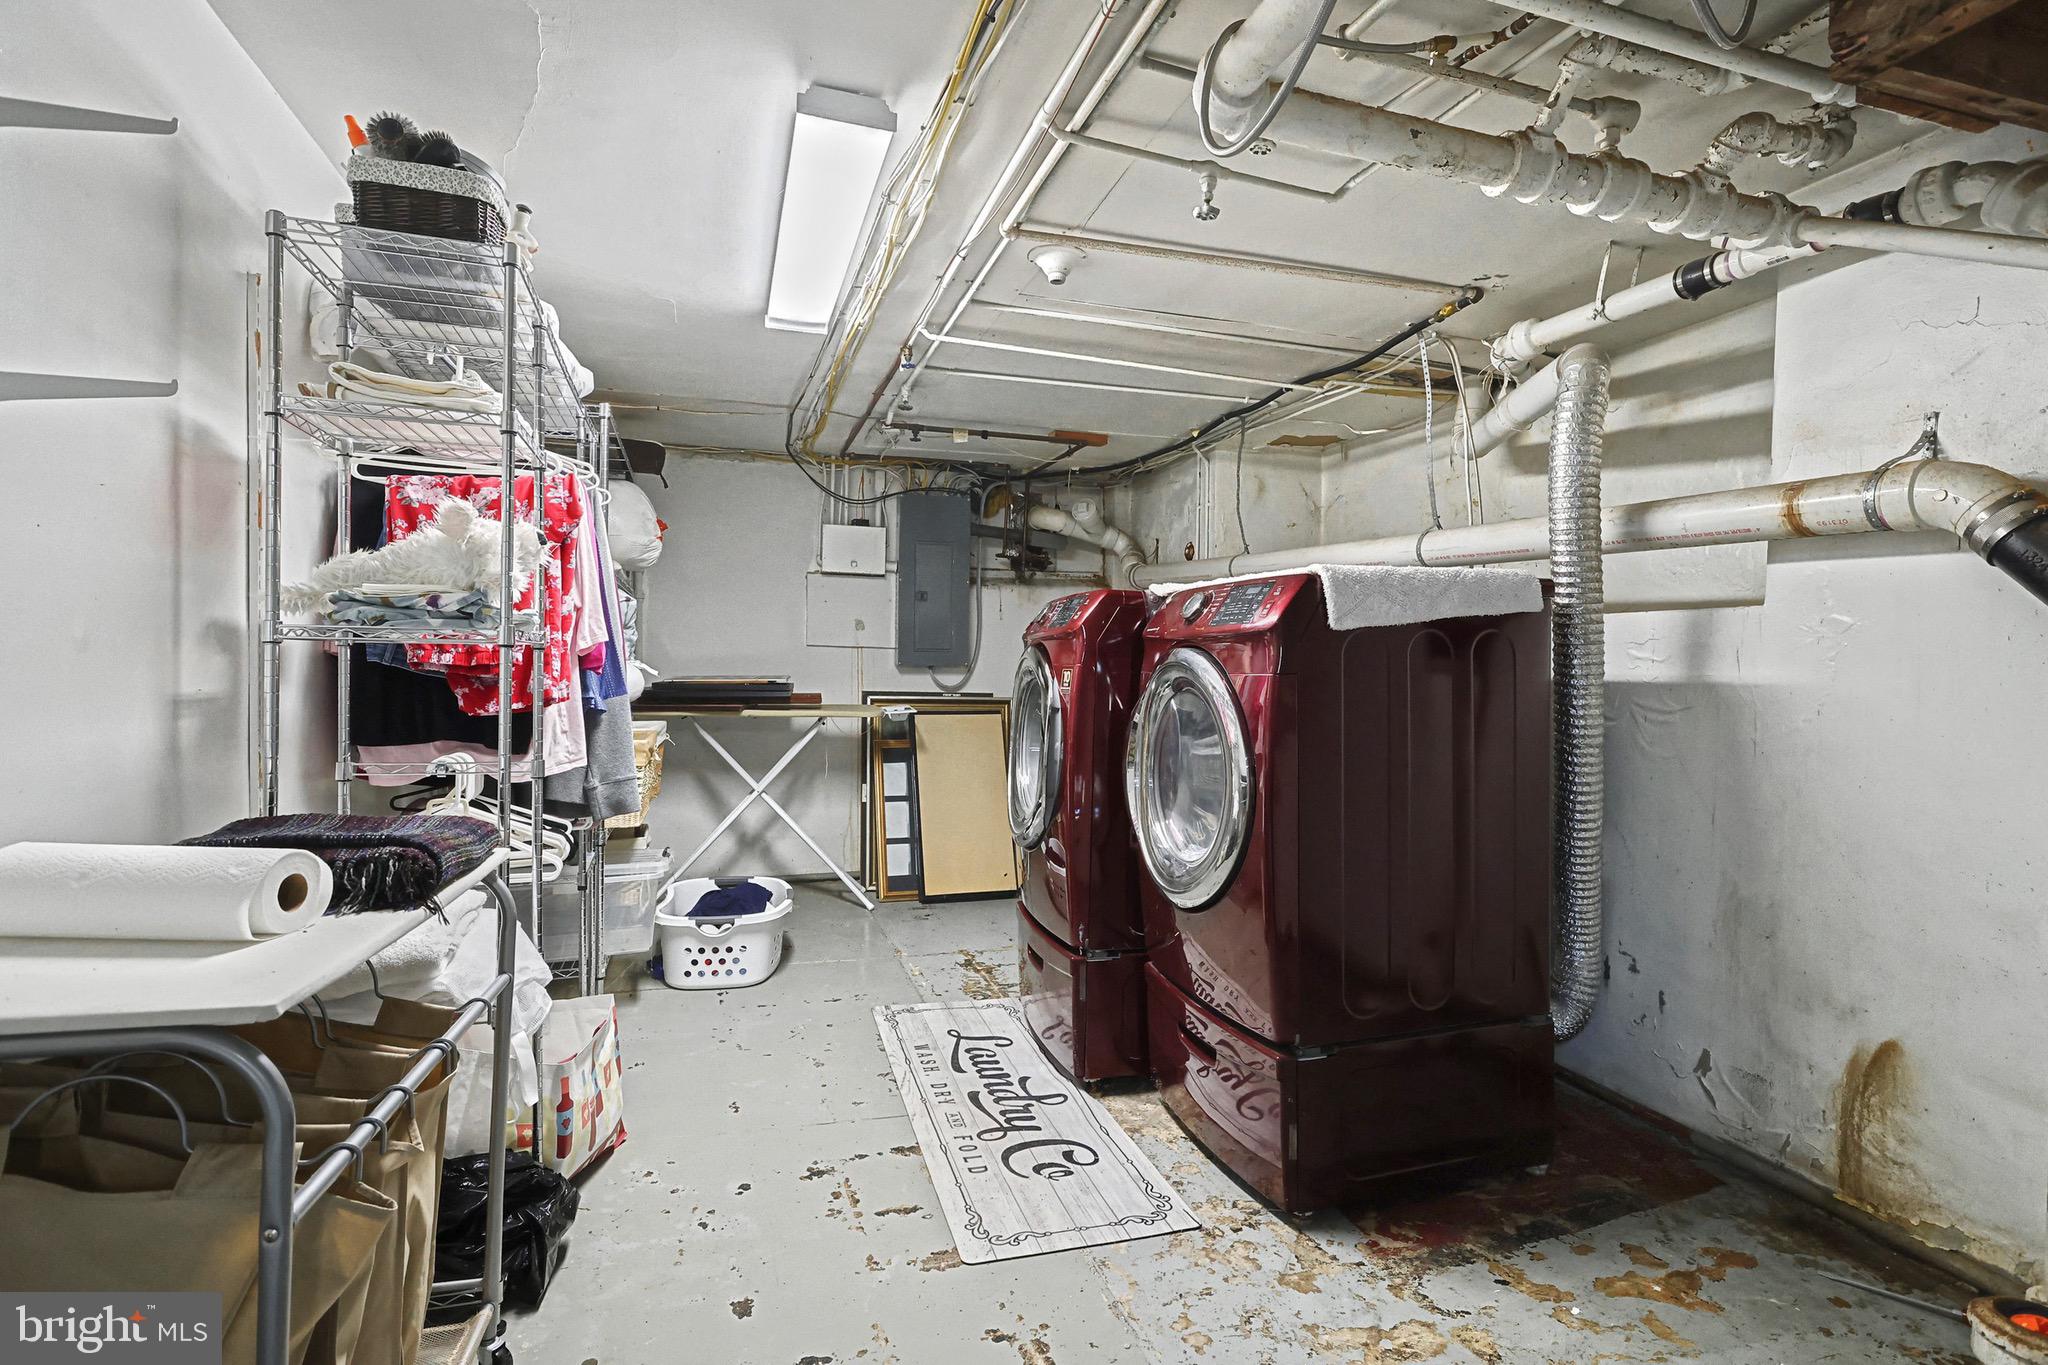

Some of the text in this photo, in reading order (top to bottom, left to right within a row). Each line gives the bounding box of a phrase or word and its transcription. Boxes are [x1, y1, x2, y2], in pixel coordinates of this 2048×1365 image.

[930, 1083, 956, 1104] DRY
[947, 1029, 1099, 1181] Laundry Co
[949, 1112, 963, 1128] AND
[954, 1135, 988, 1174] FOLD
